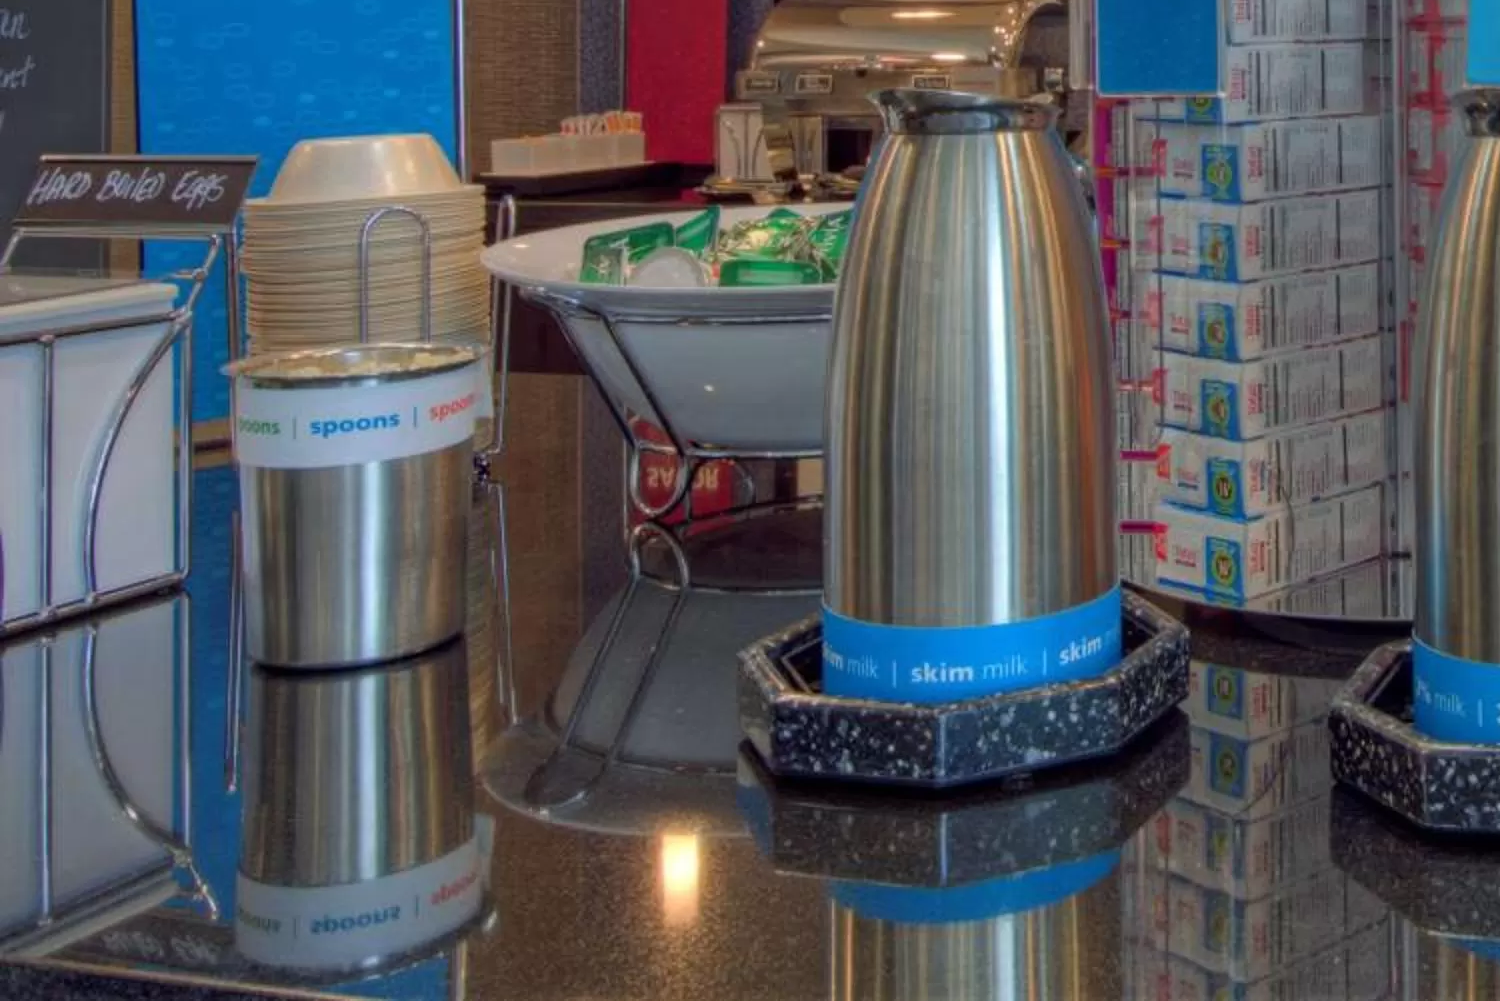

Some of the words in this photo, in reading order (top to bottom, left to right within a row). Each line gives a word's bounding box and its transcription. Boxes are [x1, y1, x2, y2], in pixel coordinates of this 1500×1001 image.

[27, 166, 92, 205] HARD
[310, 412, 401, 438] spoons
[847, 654, 879, 680] milk
[911, 661, 974, 684] skim
[982, 657, 1028, 681] milk
[1059, 635, 1102, 667] skim
